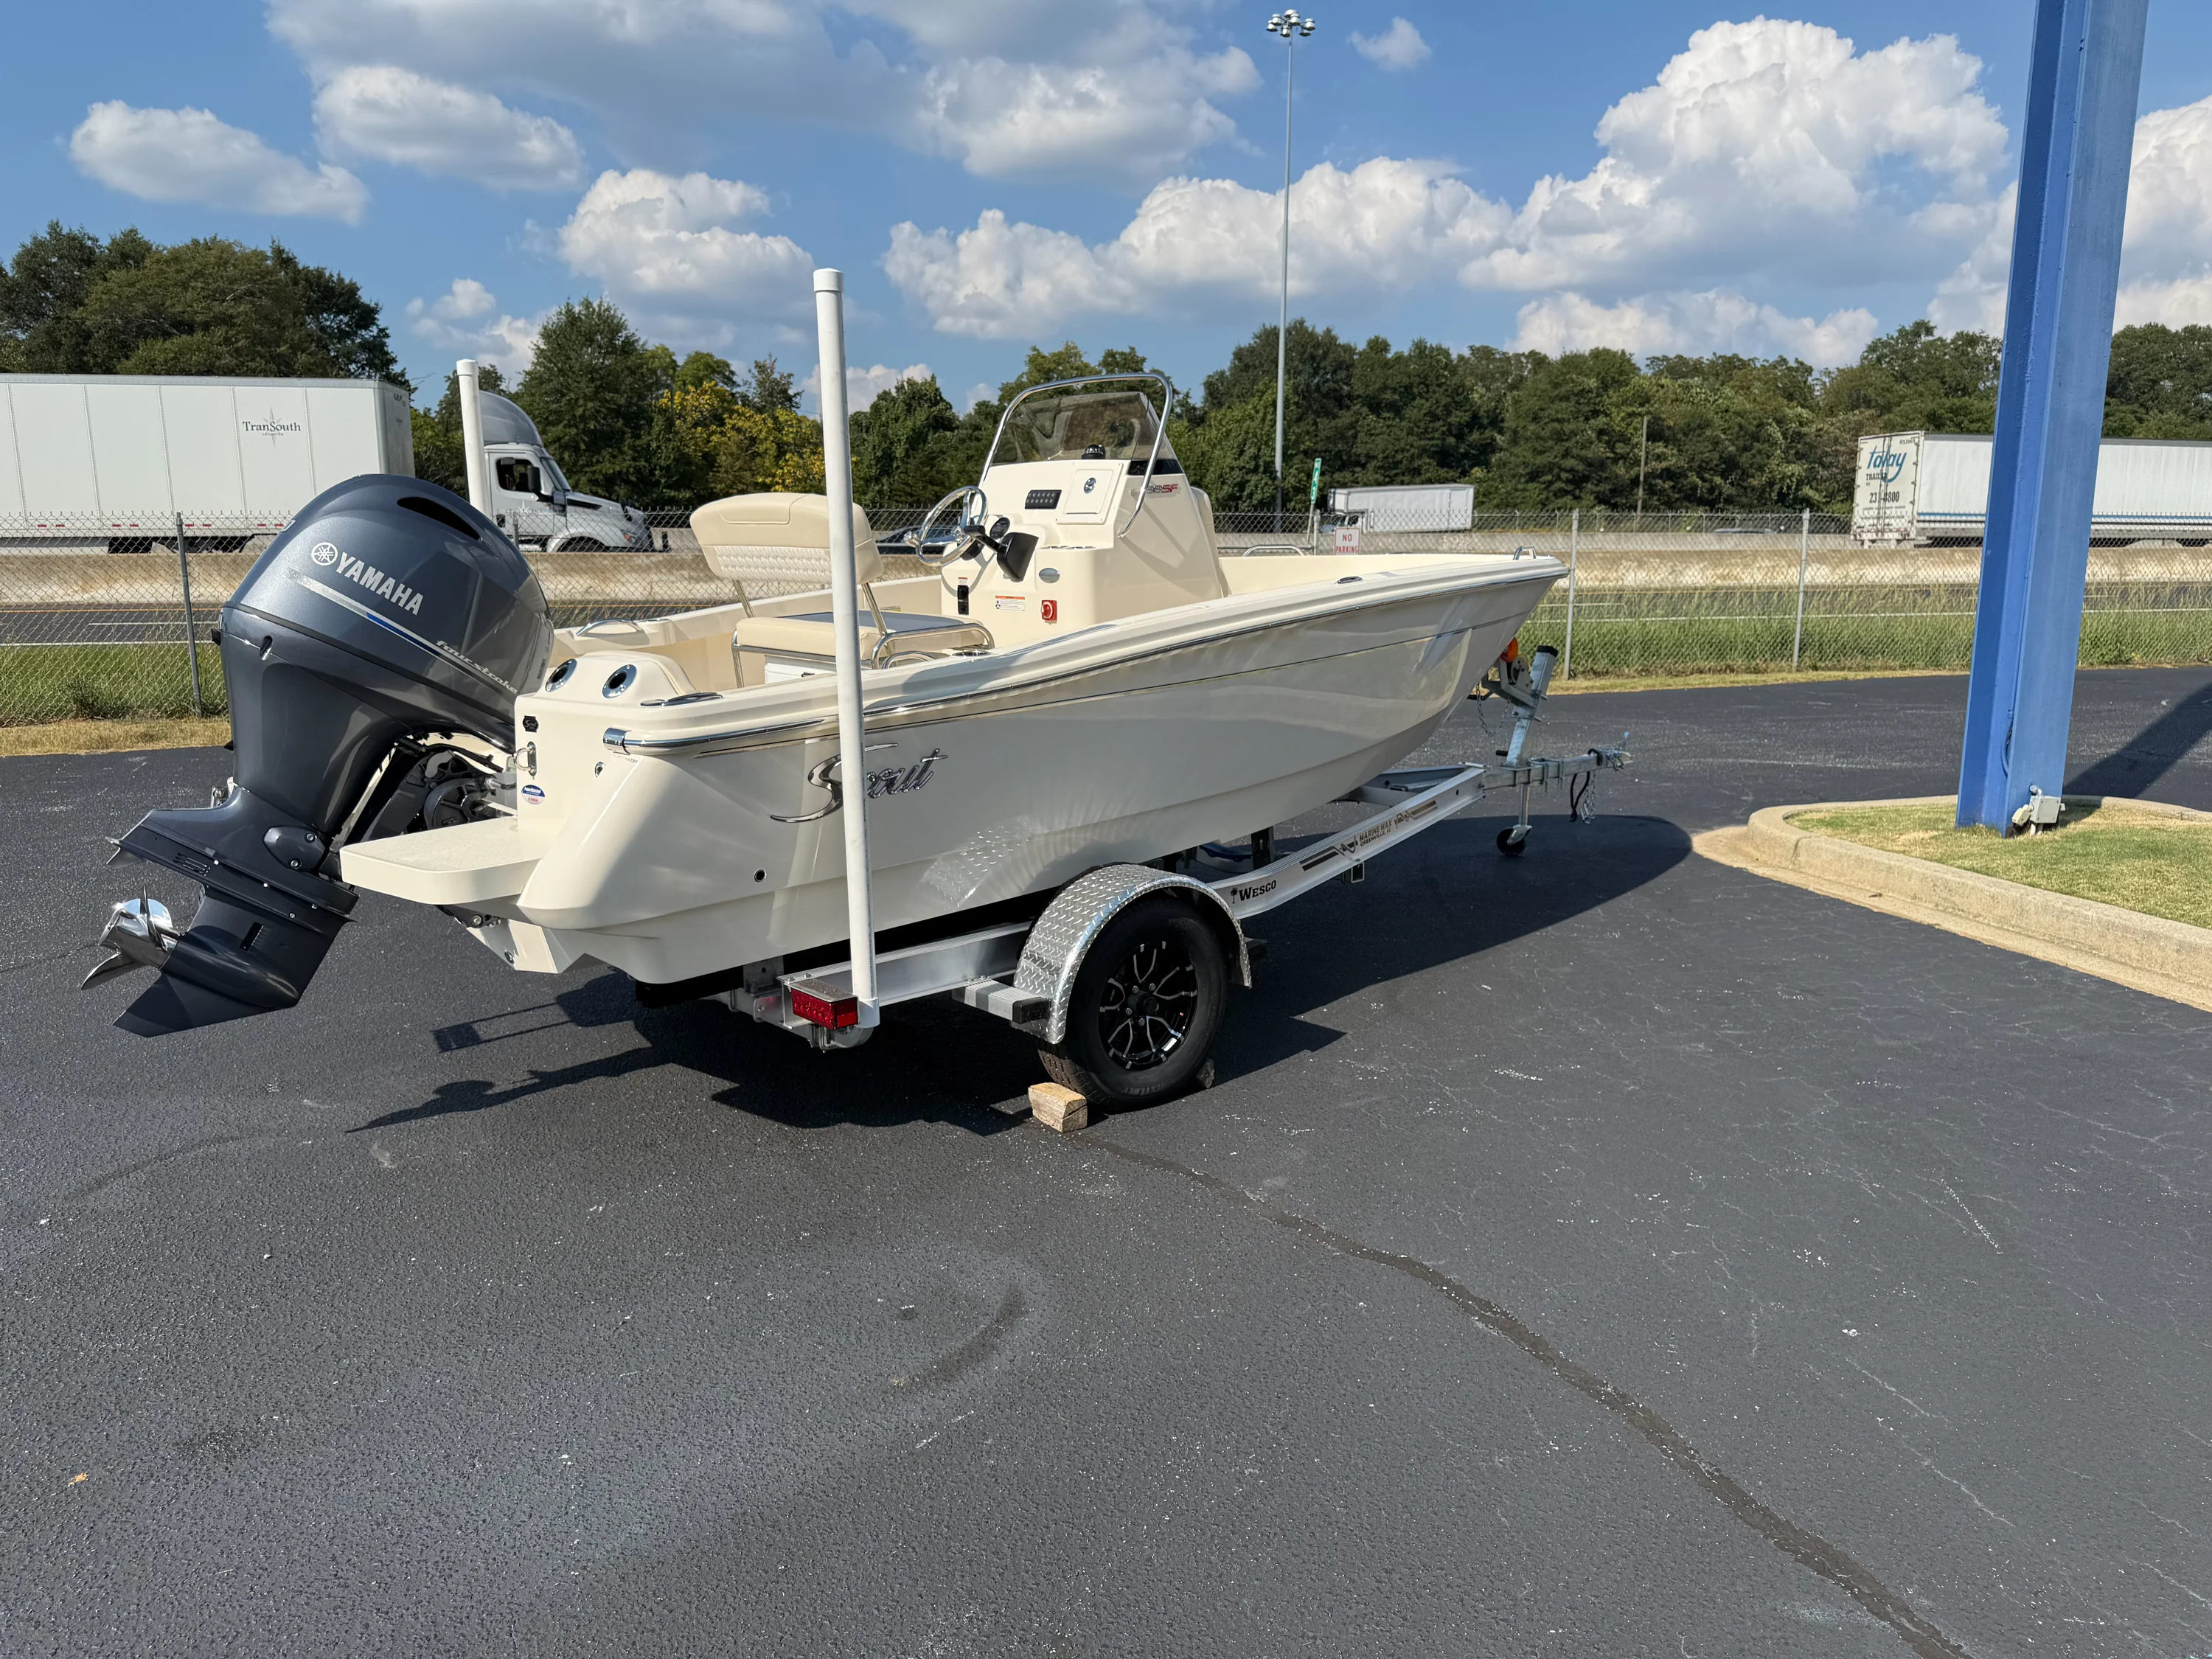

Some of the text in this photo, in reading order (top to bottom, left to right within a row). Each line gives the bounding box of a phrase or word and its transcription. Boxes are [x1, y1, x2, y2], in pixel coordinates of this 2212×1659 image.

[242, 421, 302, 432] TranSouth
[1342, 533, 1352, 542] NO
[1335, 546, 1358, 554] PARKING
[335, 552, 424, 615] YAMAHA
[1360, 819, 1392, 842] MARINE MAX
